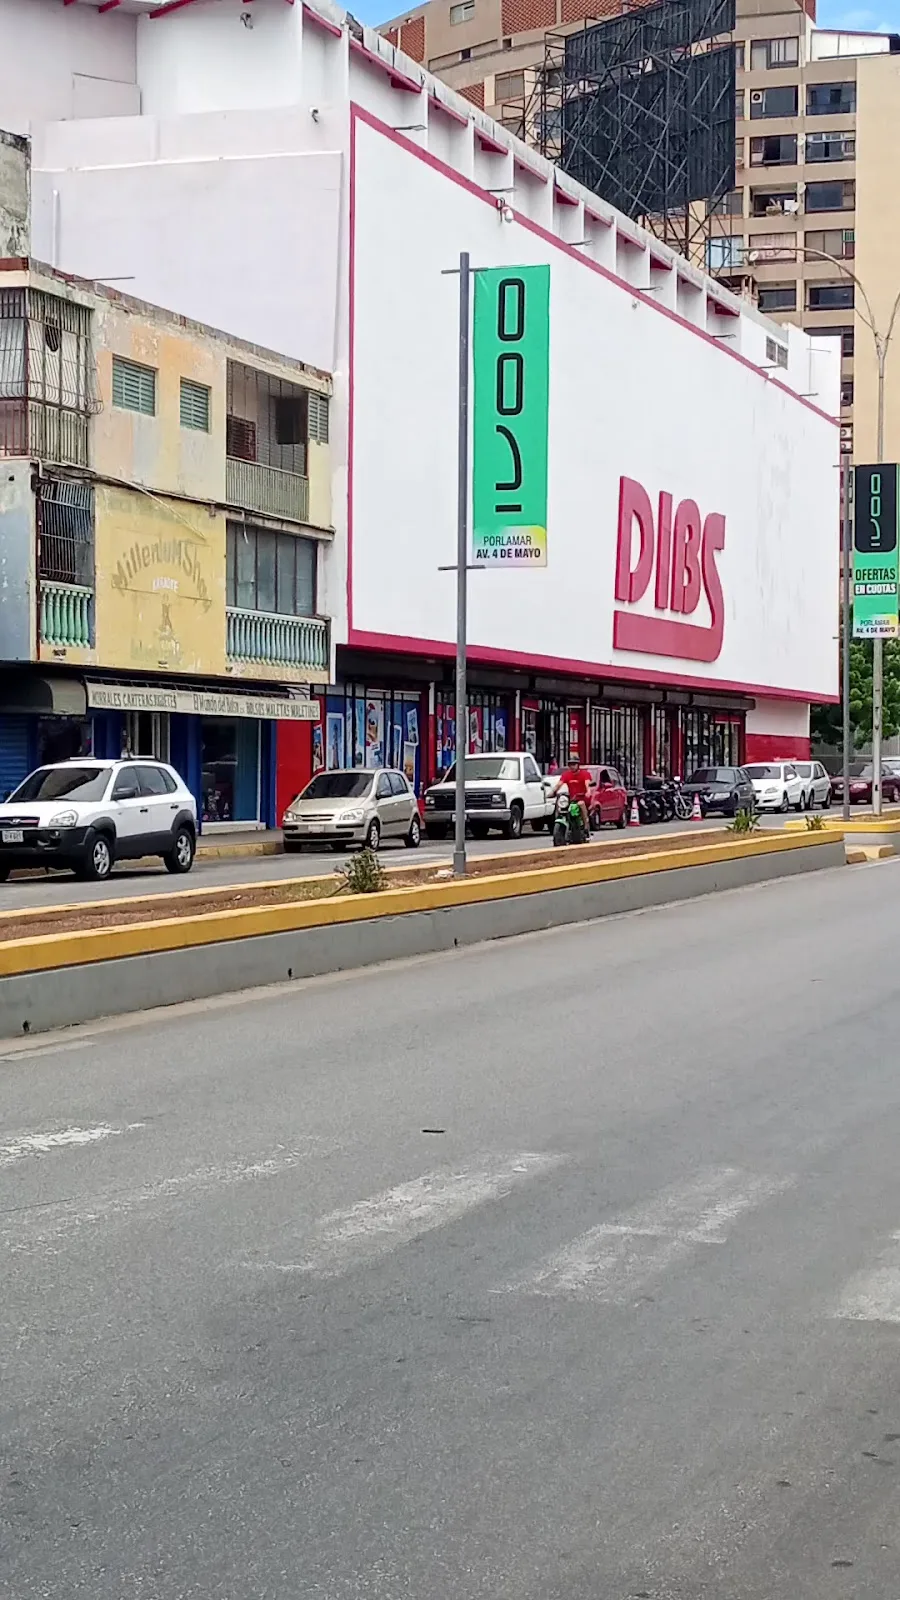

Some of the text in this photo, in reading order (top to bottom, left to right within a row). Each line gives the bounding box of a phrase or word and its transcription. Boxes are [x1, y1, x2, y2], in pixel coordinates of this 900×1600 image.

[483, 535, 532, 546] PORLAMAR
[476, 547, 541, 559] AV. 4 DE MAYO
[613, 475, 726, 664] DIBS
[855, 568, 896, 581] OFERTAS
[855, 583, 896, 594] EN CUOTAS
